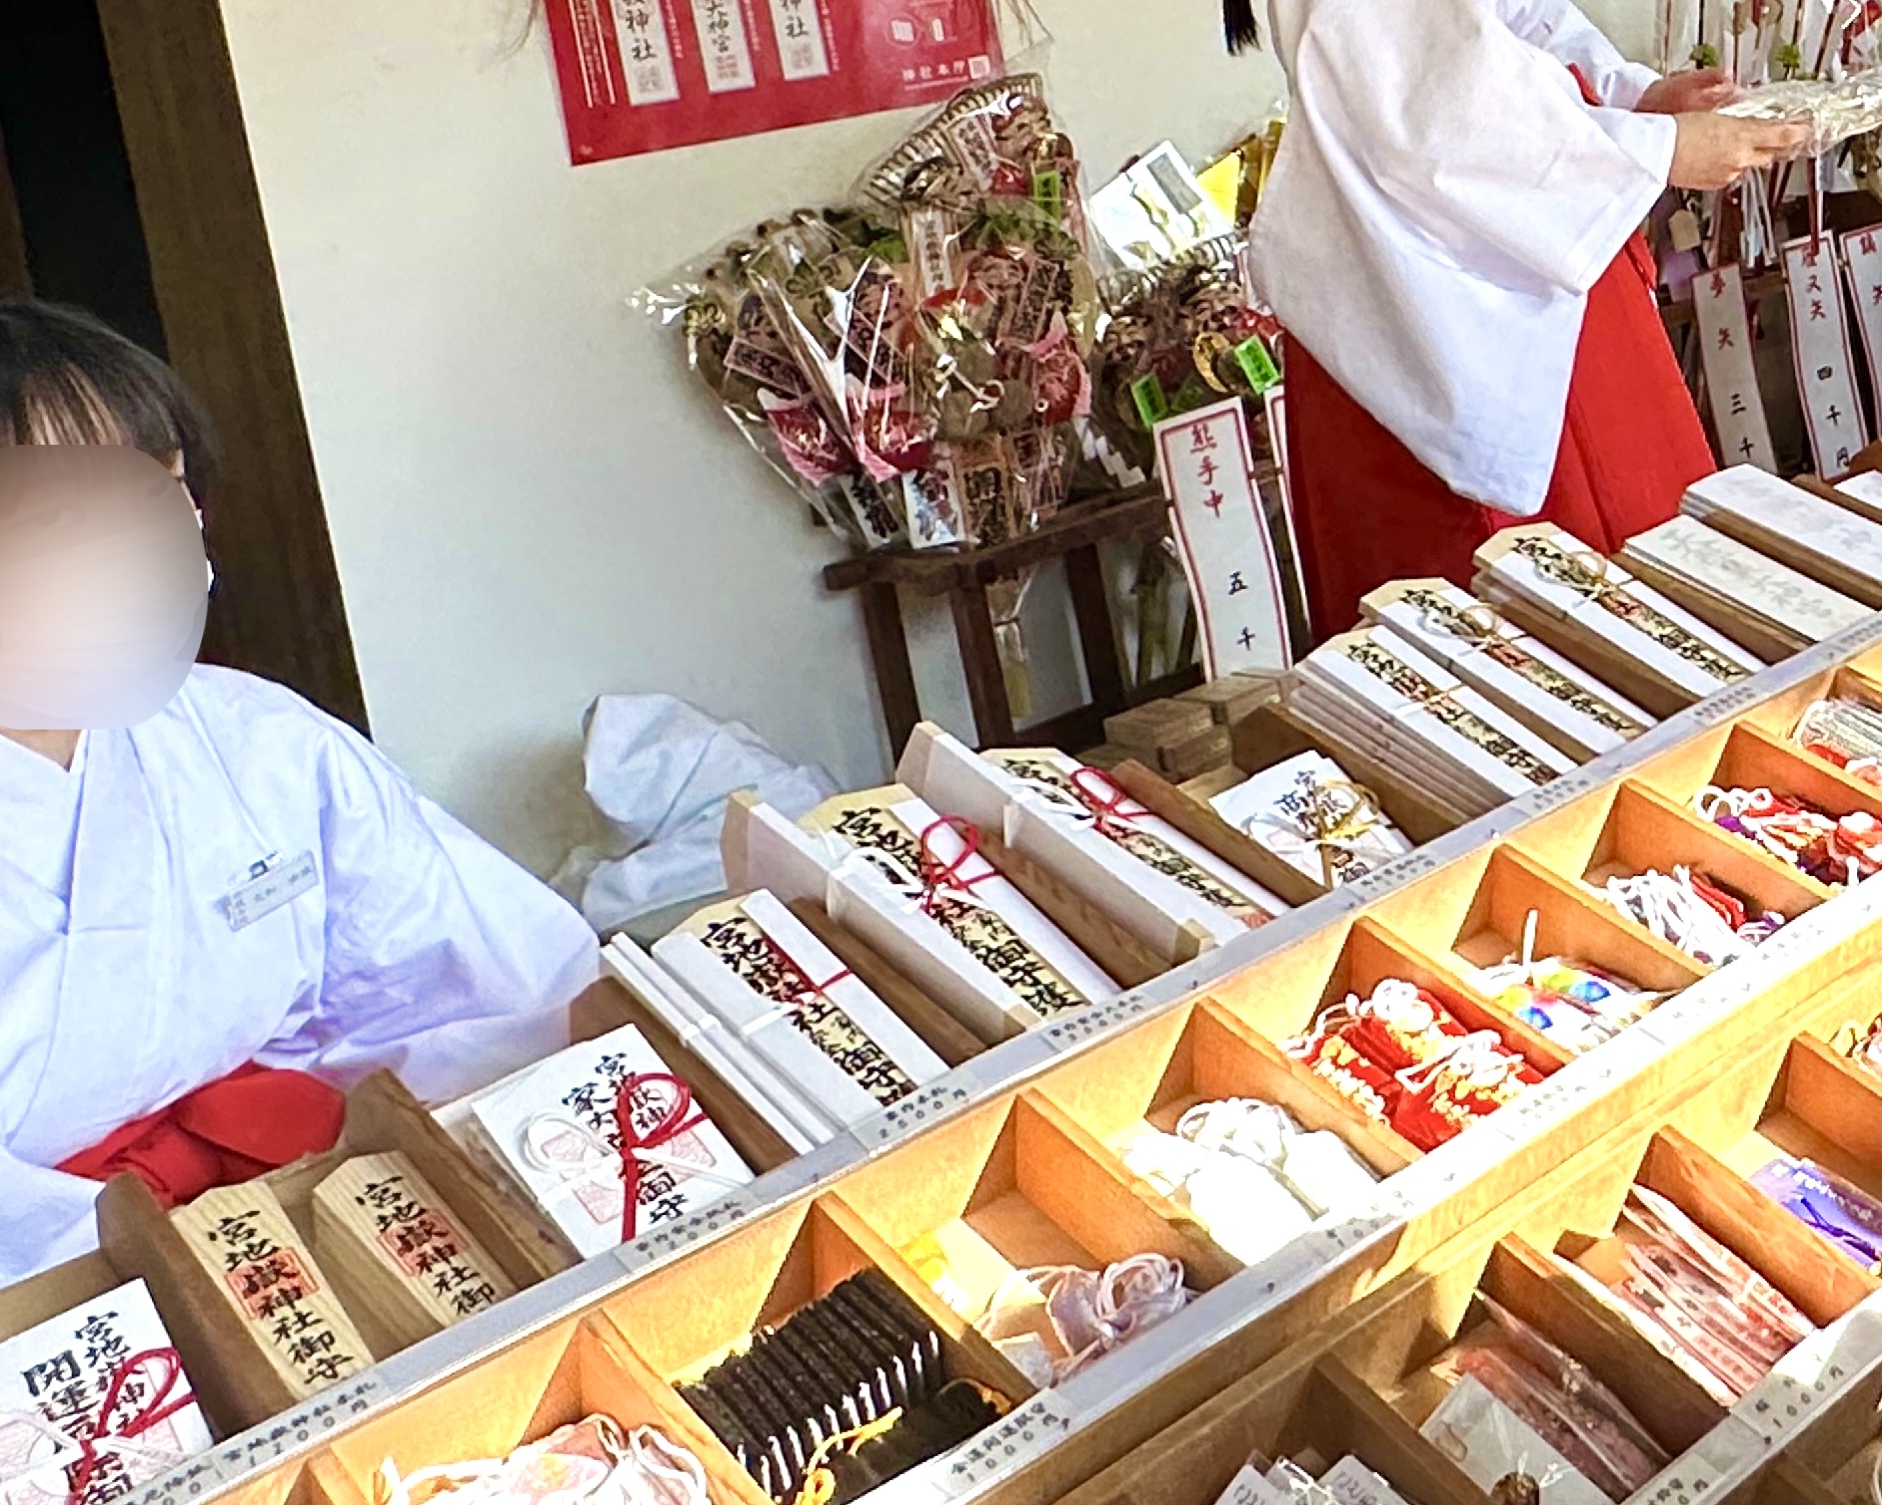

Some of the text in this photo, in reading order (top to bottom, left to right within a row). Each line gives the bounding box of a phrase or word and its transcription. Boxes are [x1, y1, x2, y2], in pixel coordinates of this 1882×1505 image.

[1730, 394, 1755, 458] 三千
[1190, 424, 1256, 651] 熊手中 五千
[877, 1088, 967, 1139] 2500円
[208, 1209, 354, 1385] 宮地嶽神社御守
[225, 1381, 376, 1462] 宮地嶽神社木札
[1771, 1363, 1844, 1428] 1000円
[250, 1400, 368, 1467] 1200円
